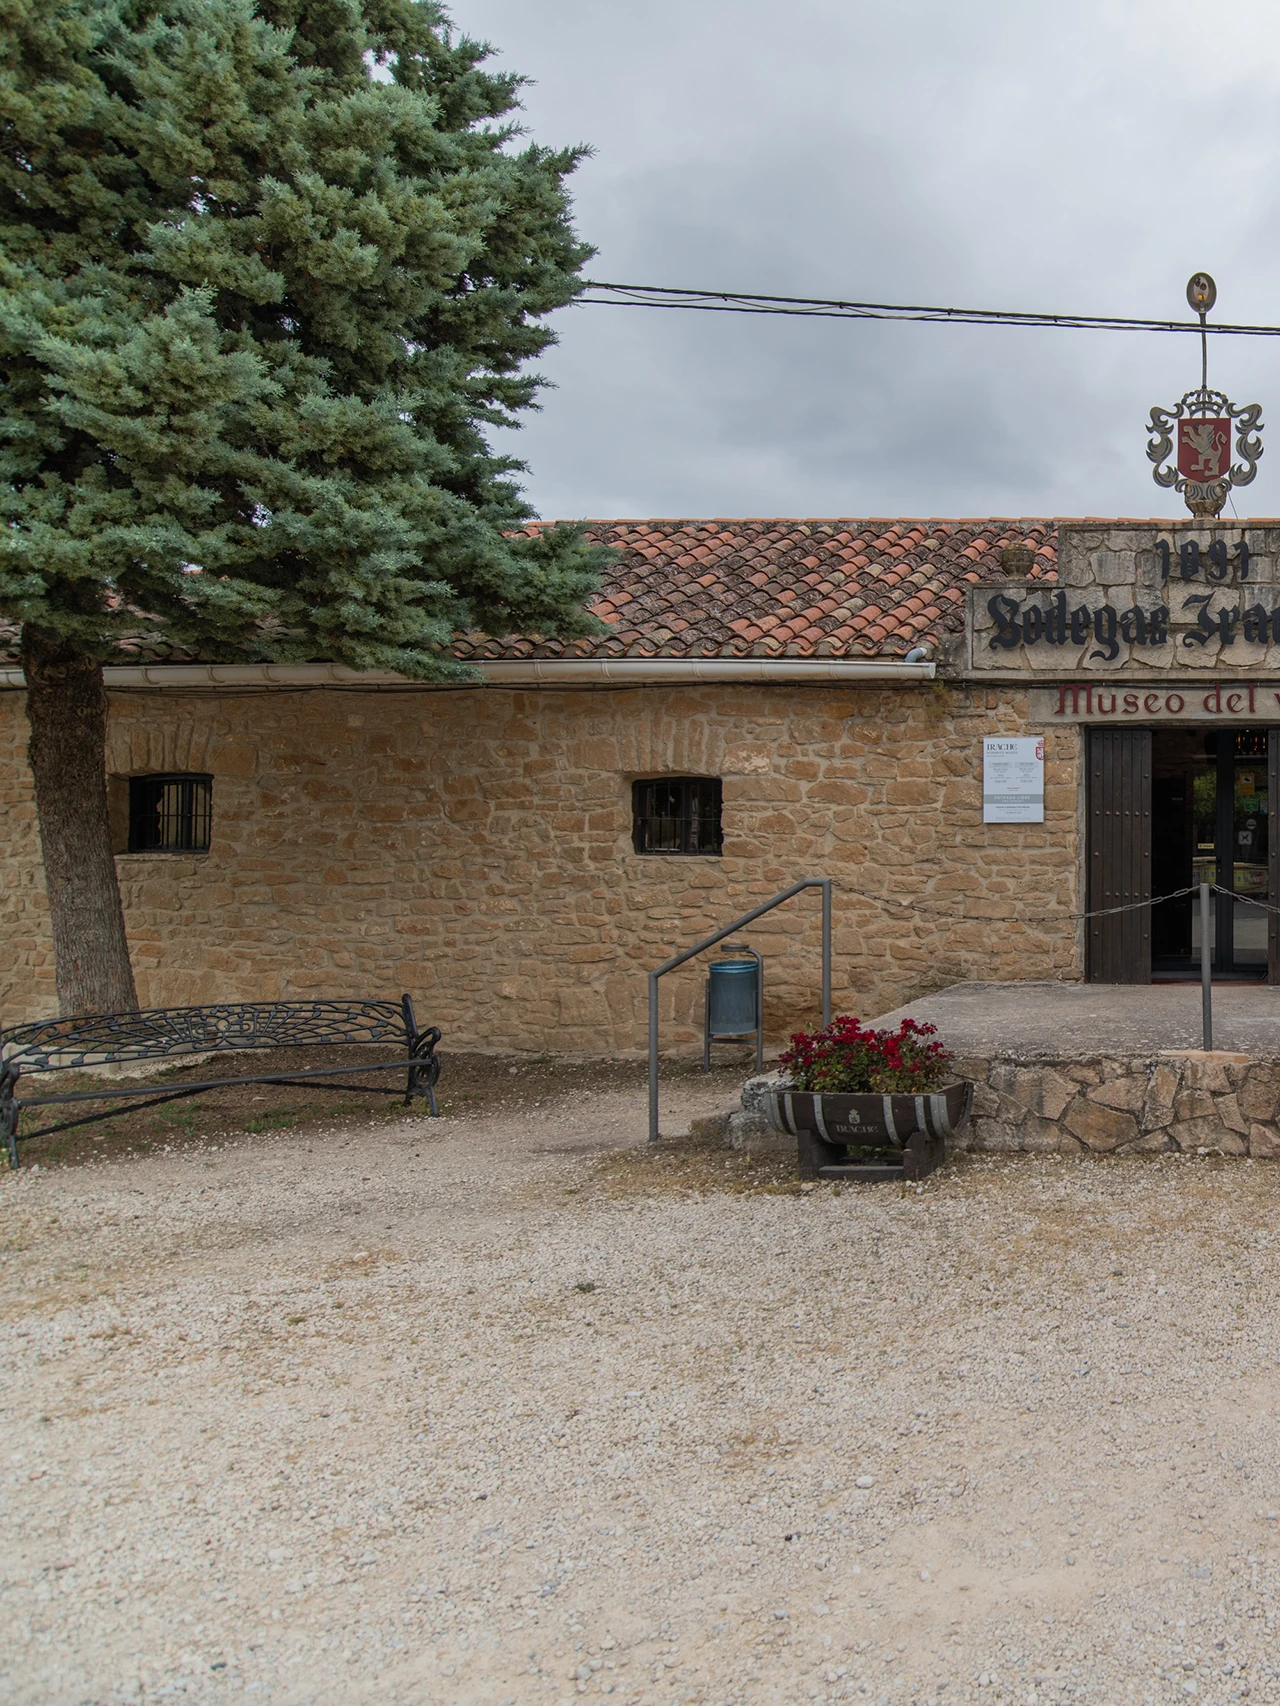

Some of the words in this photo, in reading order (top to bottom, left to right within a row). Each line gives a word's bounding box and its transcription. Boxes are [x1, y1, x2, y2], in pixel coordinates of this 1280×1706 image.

[987, 590, 1170, 661] Bodegas
[1054, 683, 1185, 714] Museo
[1203, 683, 1257, 713] del
[986, 743, 1018, 751] IRACHE
[835, 1125, 879, 1134] IRACHE
